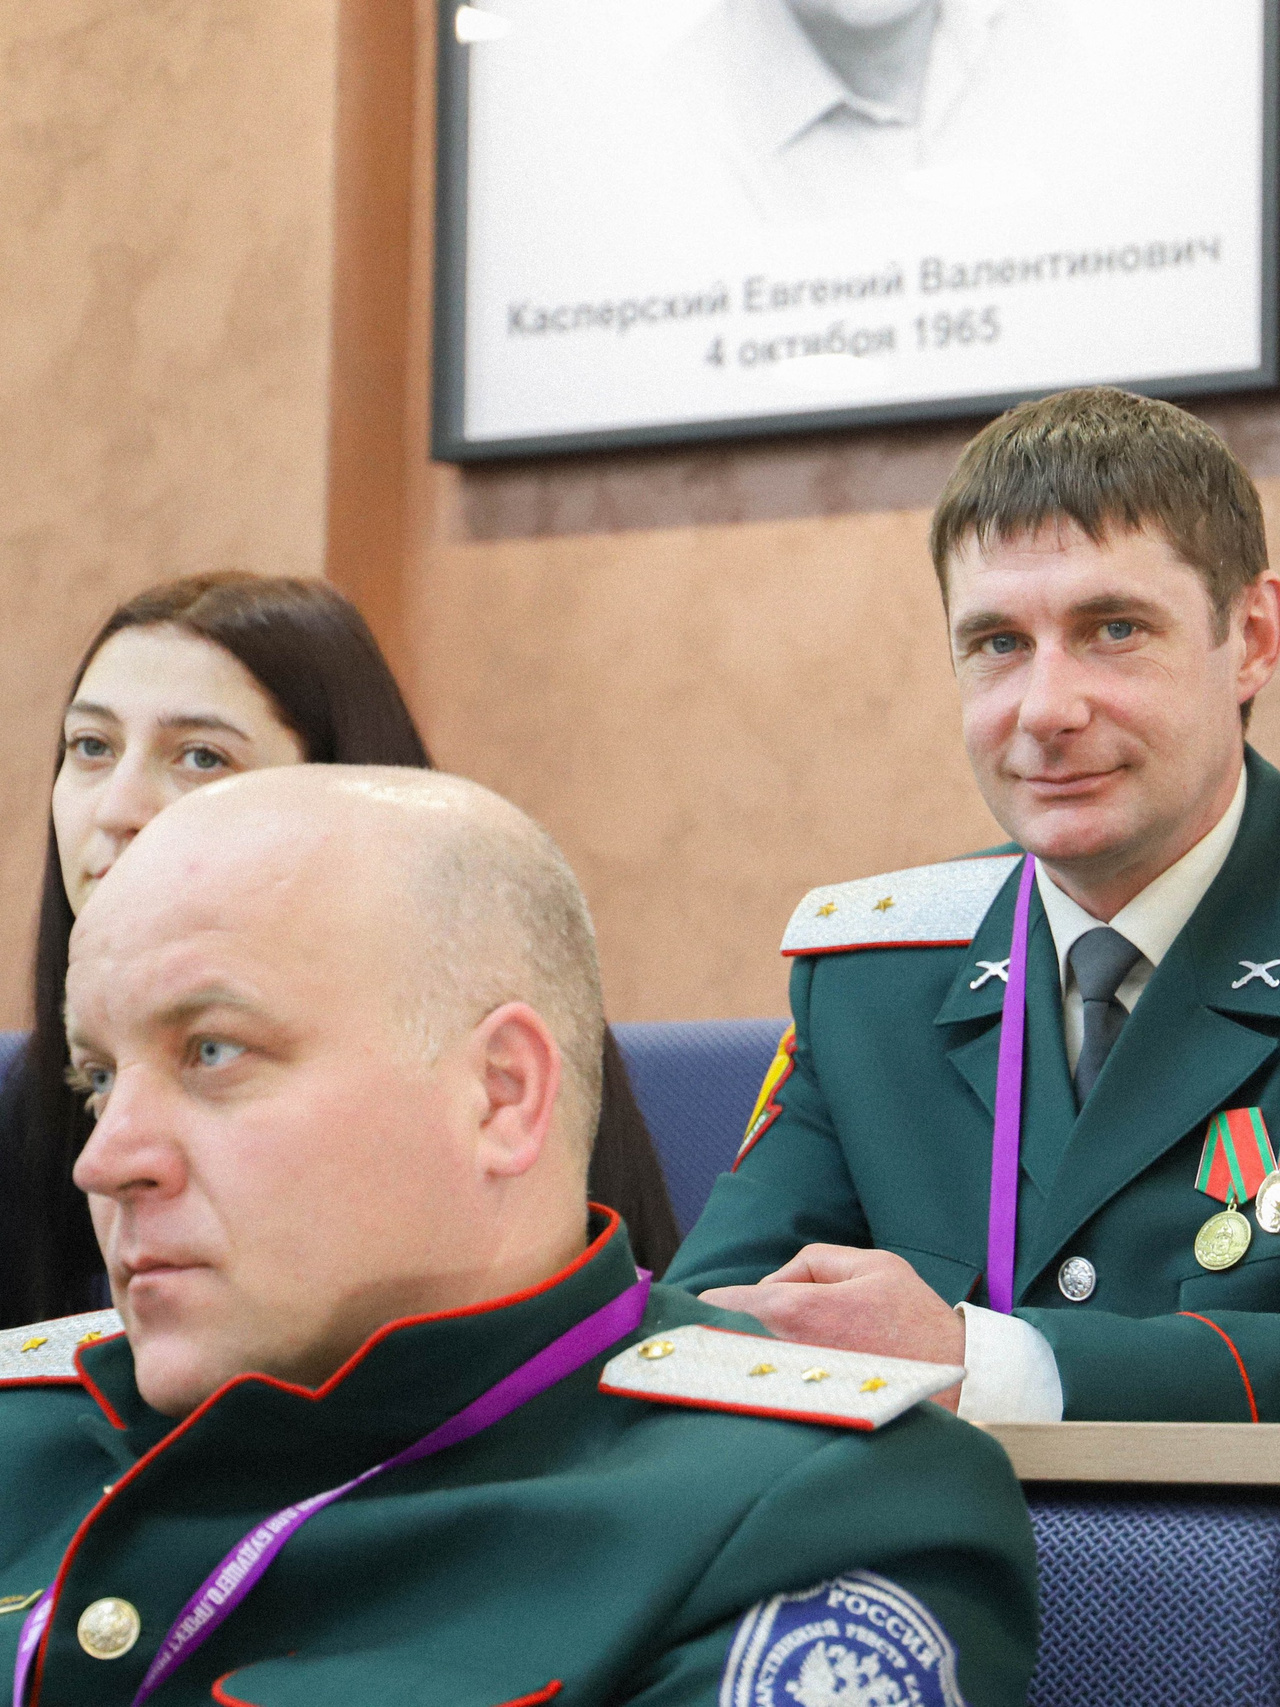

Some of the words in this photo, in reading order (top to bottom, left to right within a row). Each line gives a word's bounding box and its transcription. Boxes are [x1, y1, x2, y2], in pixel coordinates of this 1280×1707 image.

[507, 280, 729, 337] Касперский
[742, 261, 903, 313] Евгений
[919, 233, 1222, 294] Валентинович
[704, 334, 725, 367] 4
[738, 320, 896, 369] октября
[914, 304, 1002, 352] 1965
[827, 1588, 943, 1671] РОССИЯ
